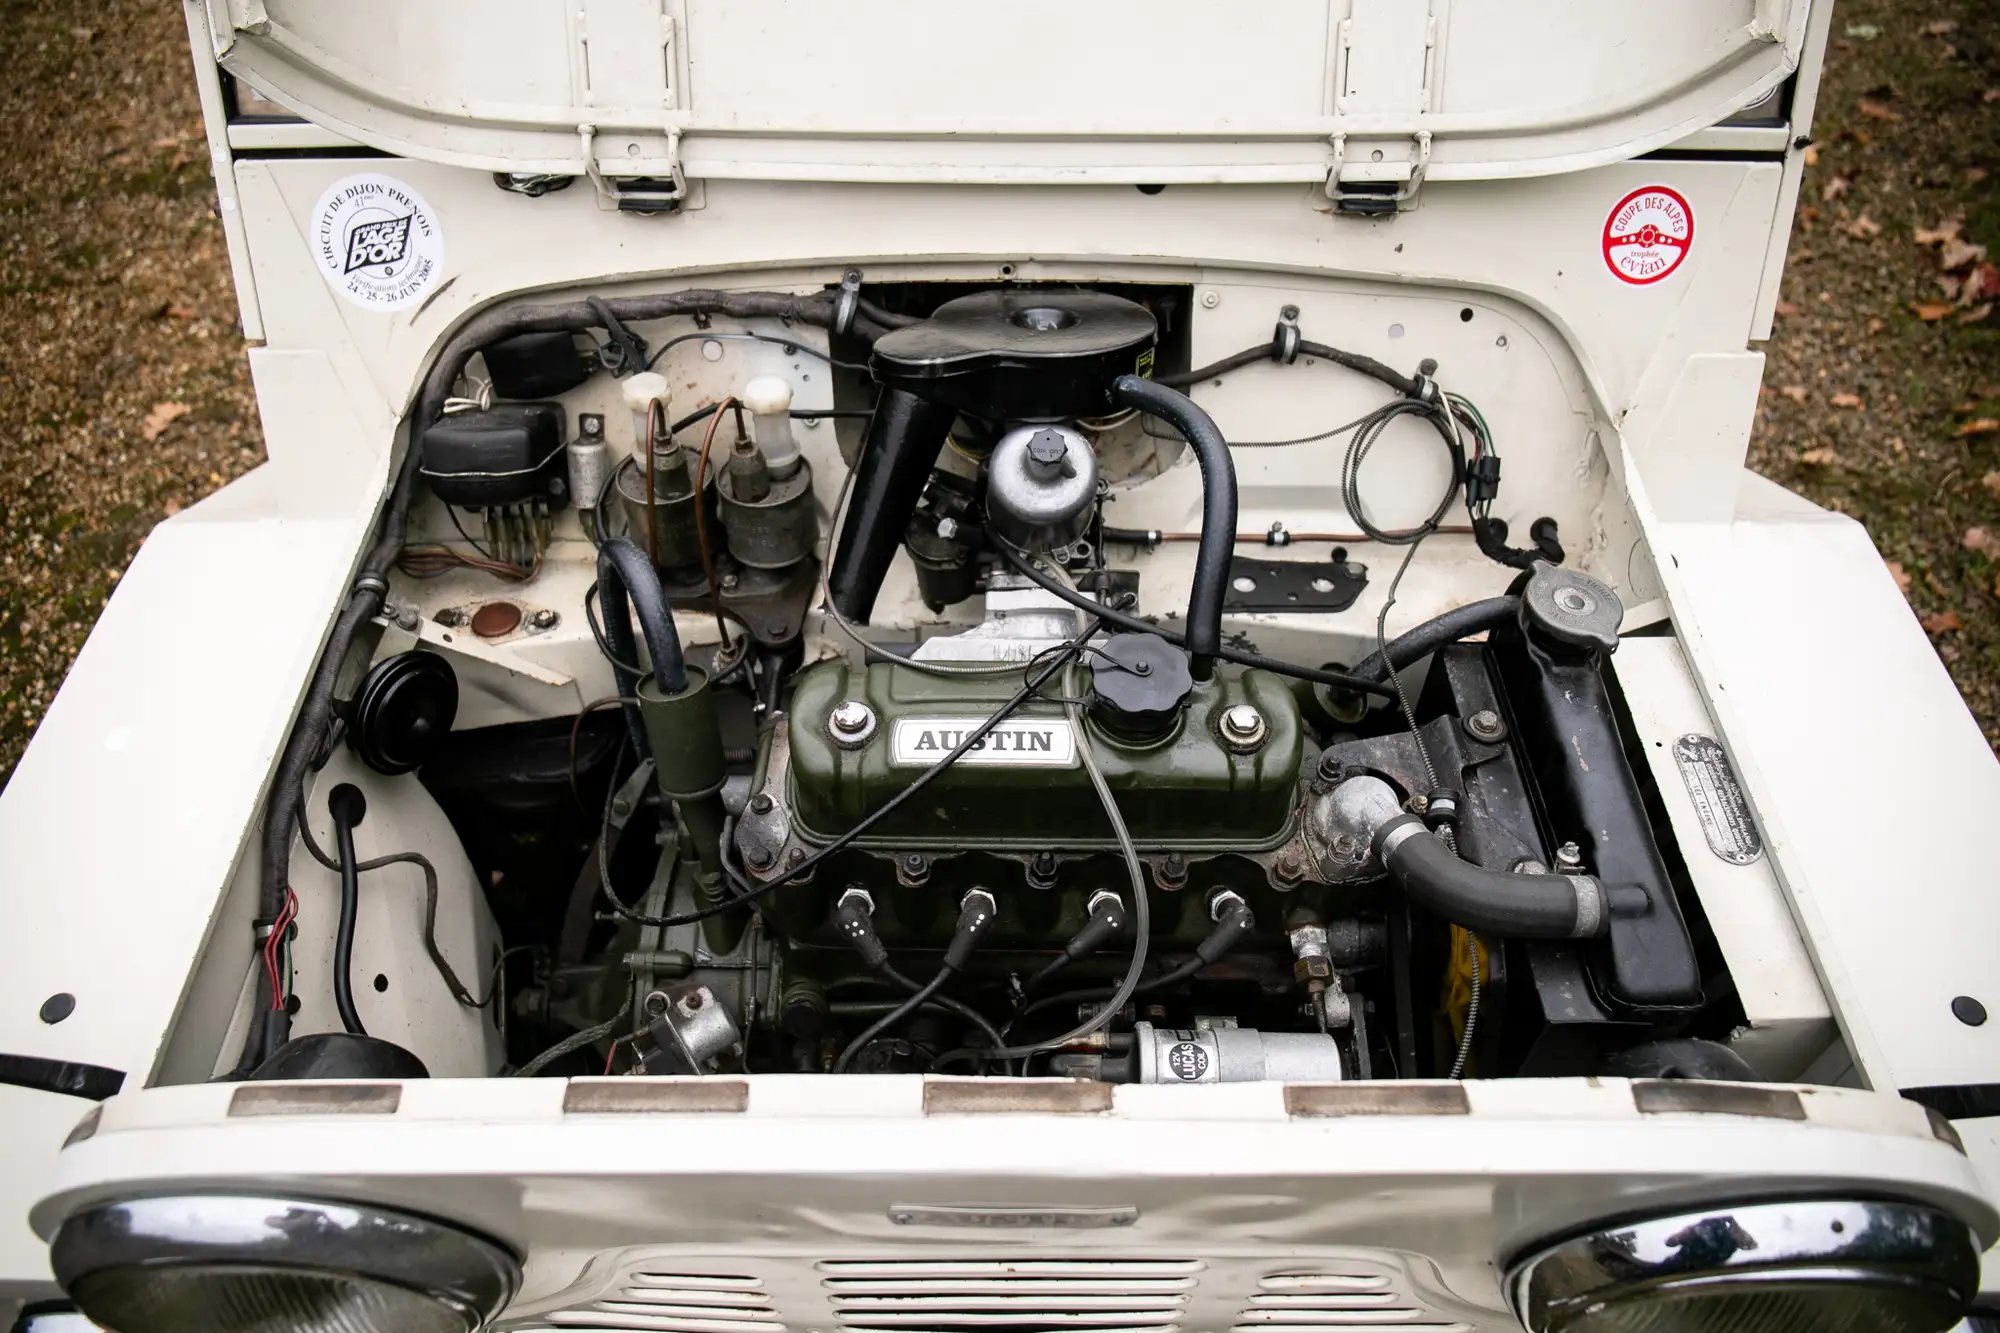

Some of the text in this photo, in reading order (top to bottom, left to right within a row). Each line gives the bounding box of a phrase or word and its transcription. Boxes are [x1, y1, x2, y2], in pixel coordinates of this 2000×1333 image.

[1615, 197, 1684, 233] COUPE DES ALPES
[320, 183, 433, 269] CIRCUIT DE DIJON PRENOIS
[1630, 250, 1660, 259] trophée
[1620, 256, 1667, 275] evian
[347, 281, 359, 293] 24
[366, 290, 378, 302] 25
[385, 292, 398, 302] 26
[400, 282, 421, 299] JUIN
[914, 730, 1053, 751] AUSTIN
[1172, 1051, 1181, 1067] 12V
[1182, 1044, 1196, 1079] LUCAS
[1197, 1051, 1207, 1070] COIL
